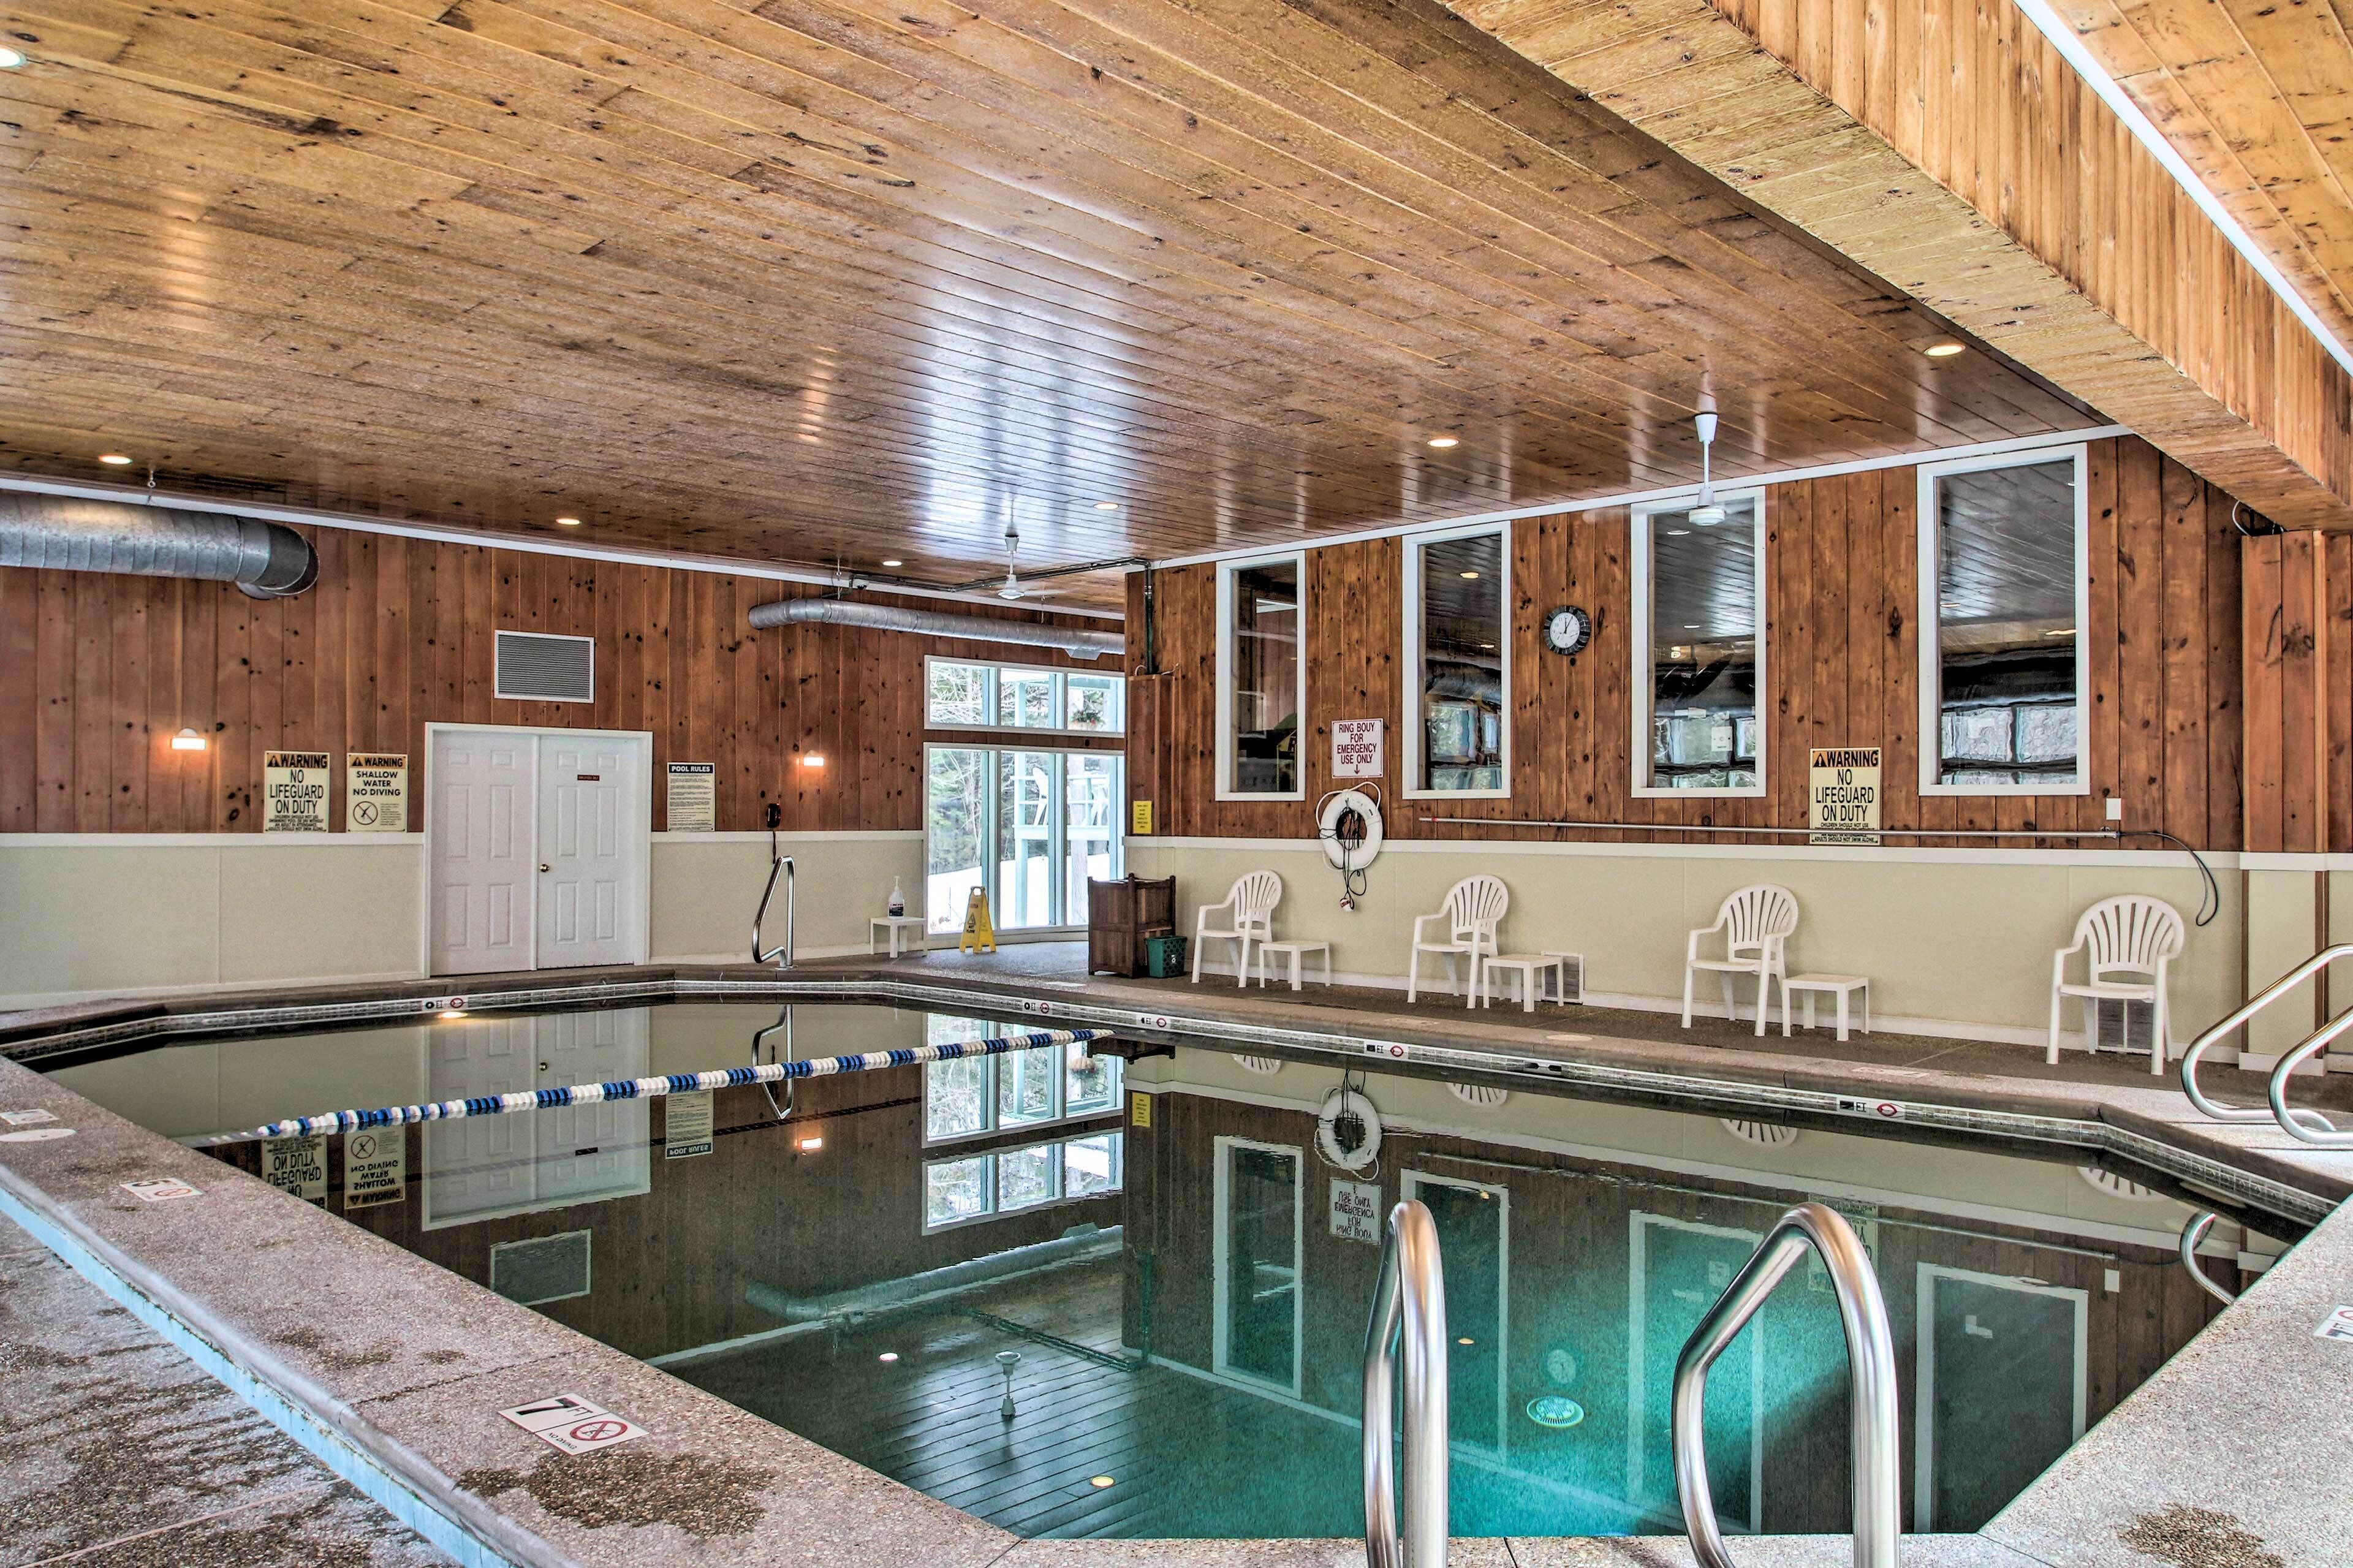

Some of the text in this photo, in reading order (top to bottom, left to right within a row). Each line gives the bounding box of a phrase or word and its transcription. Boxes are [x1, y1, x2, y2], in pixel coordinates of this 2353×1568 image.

[1339, 722, 1375, 733] RING BOUY
[1350, 733, 1363, 743] FOR
[1337, 743, 1377, 754] EMERGENCY
[281, 754, 327, 768] WARNING
[365, 757, 403, 767] WARNING
[1341, 754, 1373, 765] USE ONLY
[1827, 750, 1878, 767] WARNING
[290, 769, 305, 783] NO
[1838, 768, 1852, 786] NO
[270, 784, 324, 799] LIFEGUARD
[1816, 787, 1874, 804] LIFEGUARD
[276, 800, 317, 814] ON DUTY
[1822, 805, 1868, 822] ON DUTY
[516, 1397, 593, 1417] 7 FT
